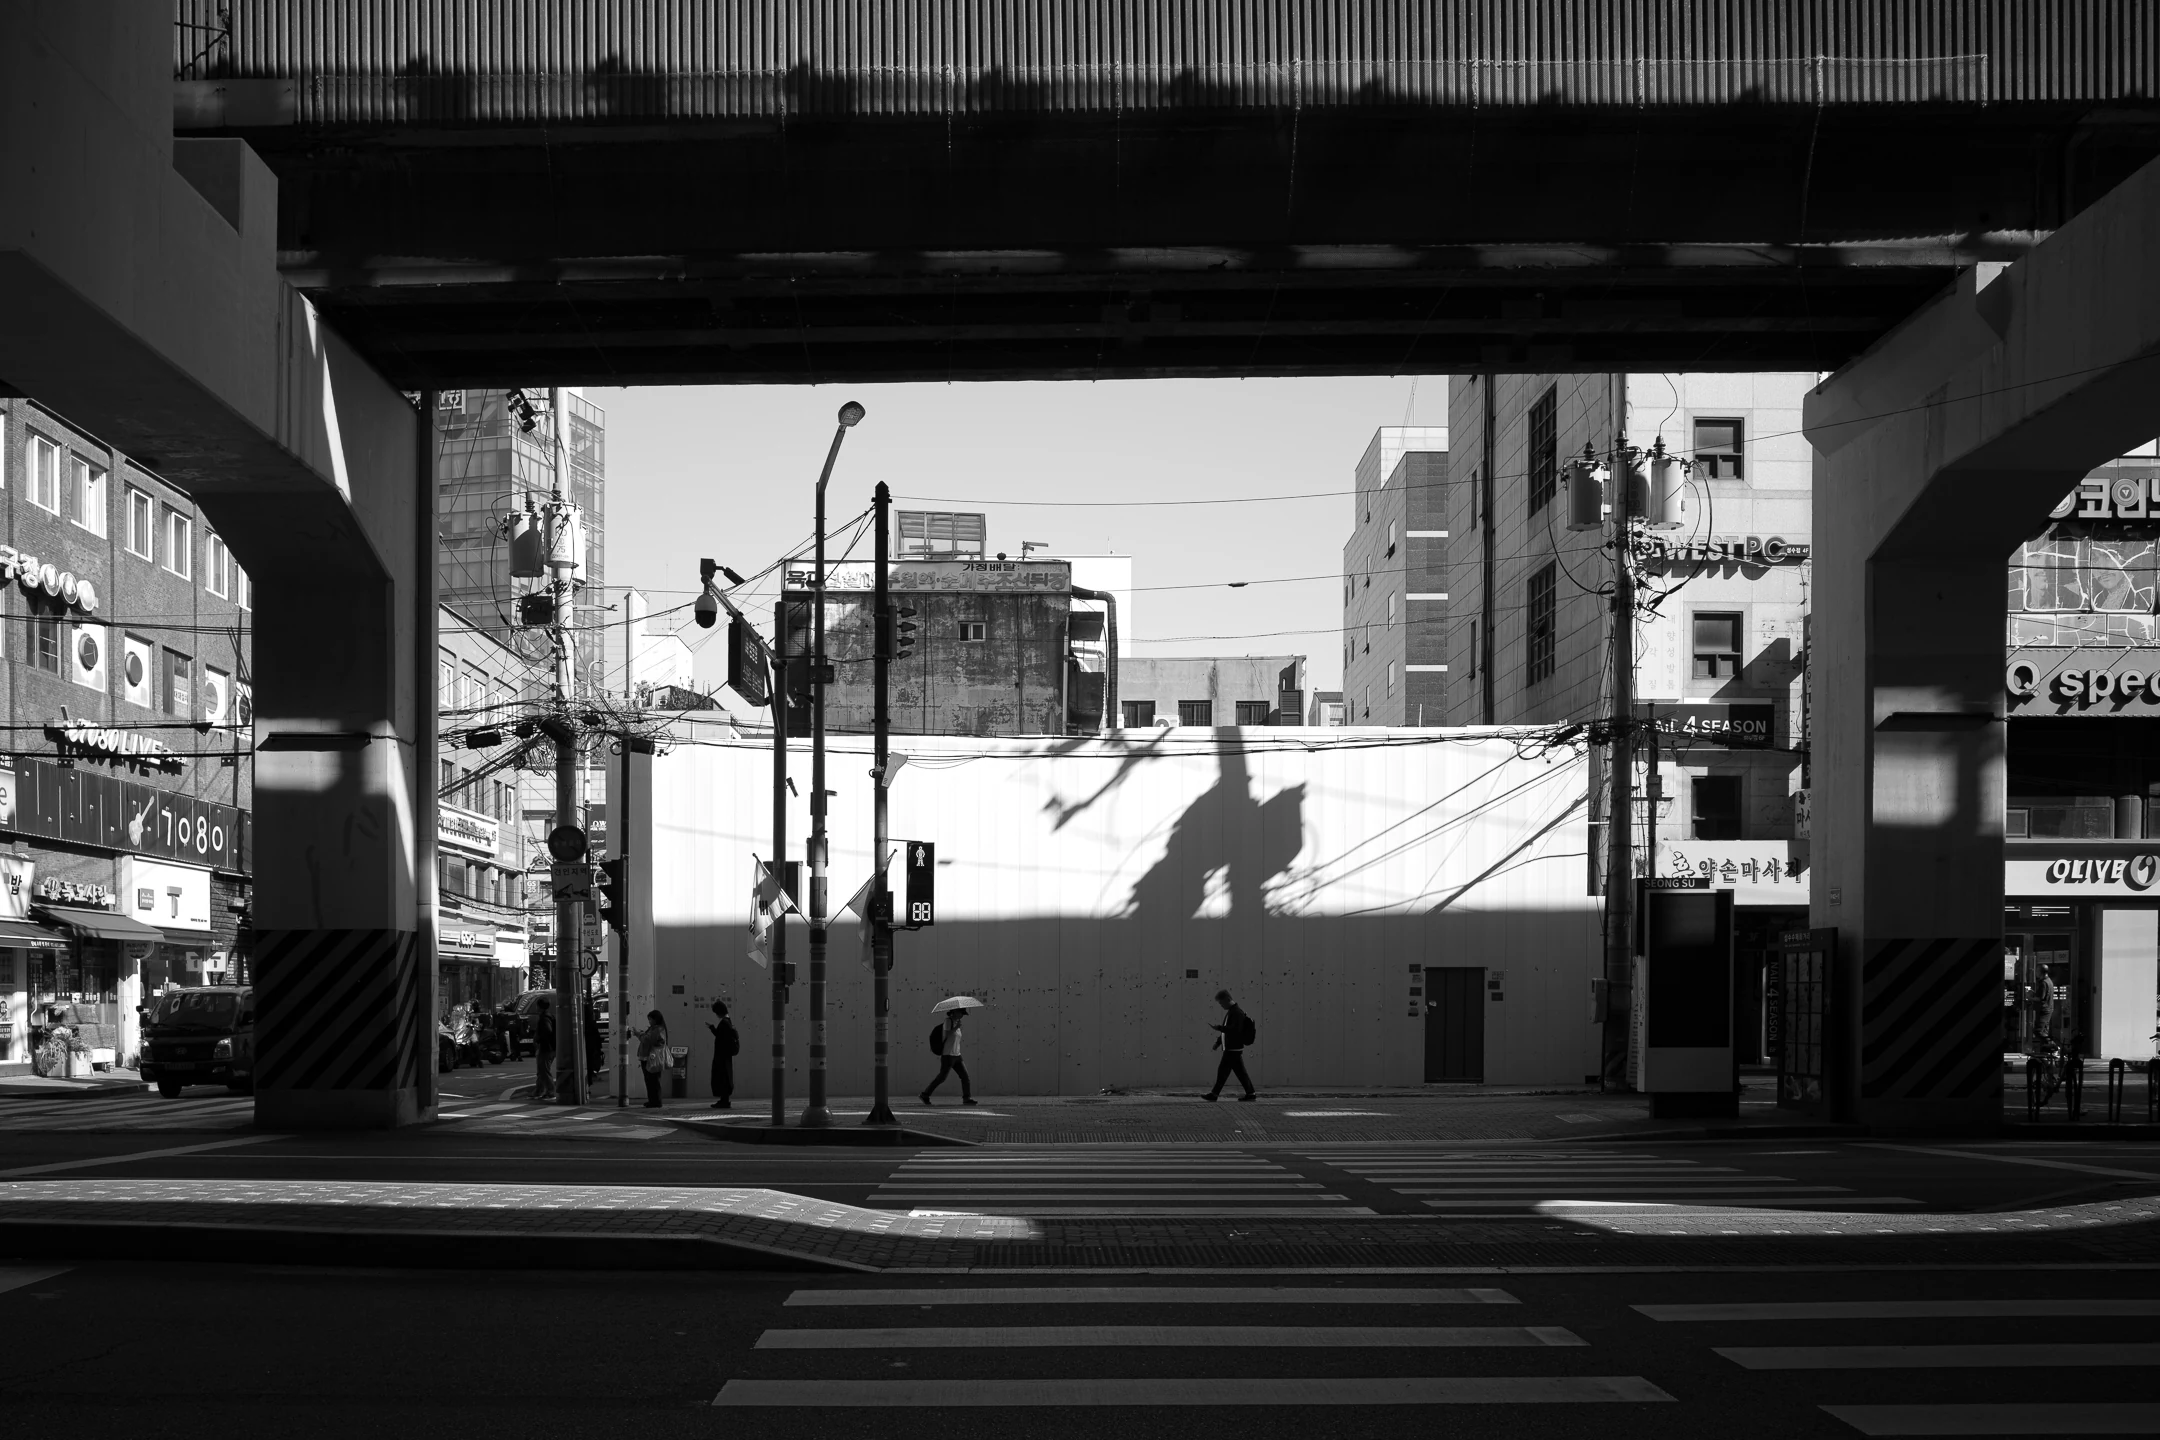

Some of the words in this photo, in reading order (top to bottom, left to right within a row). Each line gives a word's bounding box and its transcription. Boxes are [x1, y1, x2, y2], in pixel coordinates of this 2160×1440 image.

[1662, 535, 1739, 561] WEST
[1744, 535, 1788, 563] PC
[1701, 720, 1766, 733] SEASON
[161, 809, 223, 854] 7080
[1699, 857, 1801, 883] 약손마사지
[2052, 858, 2130, 880] OLIVE
[11, 875, 22, 895] 밥
[1644, 879, 1680, 888] SEONG
[1682, 879, 1695, 888] SU
[1769, 961, 1779, 985] NAIL
[1769, 1000, 1779, 1041] SEASON
